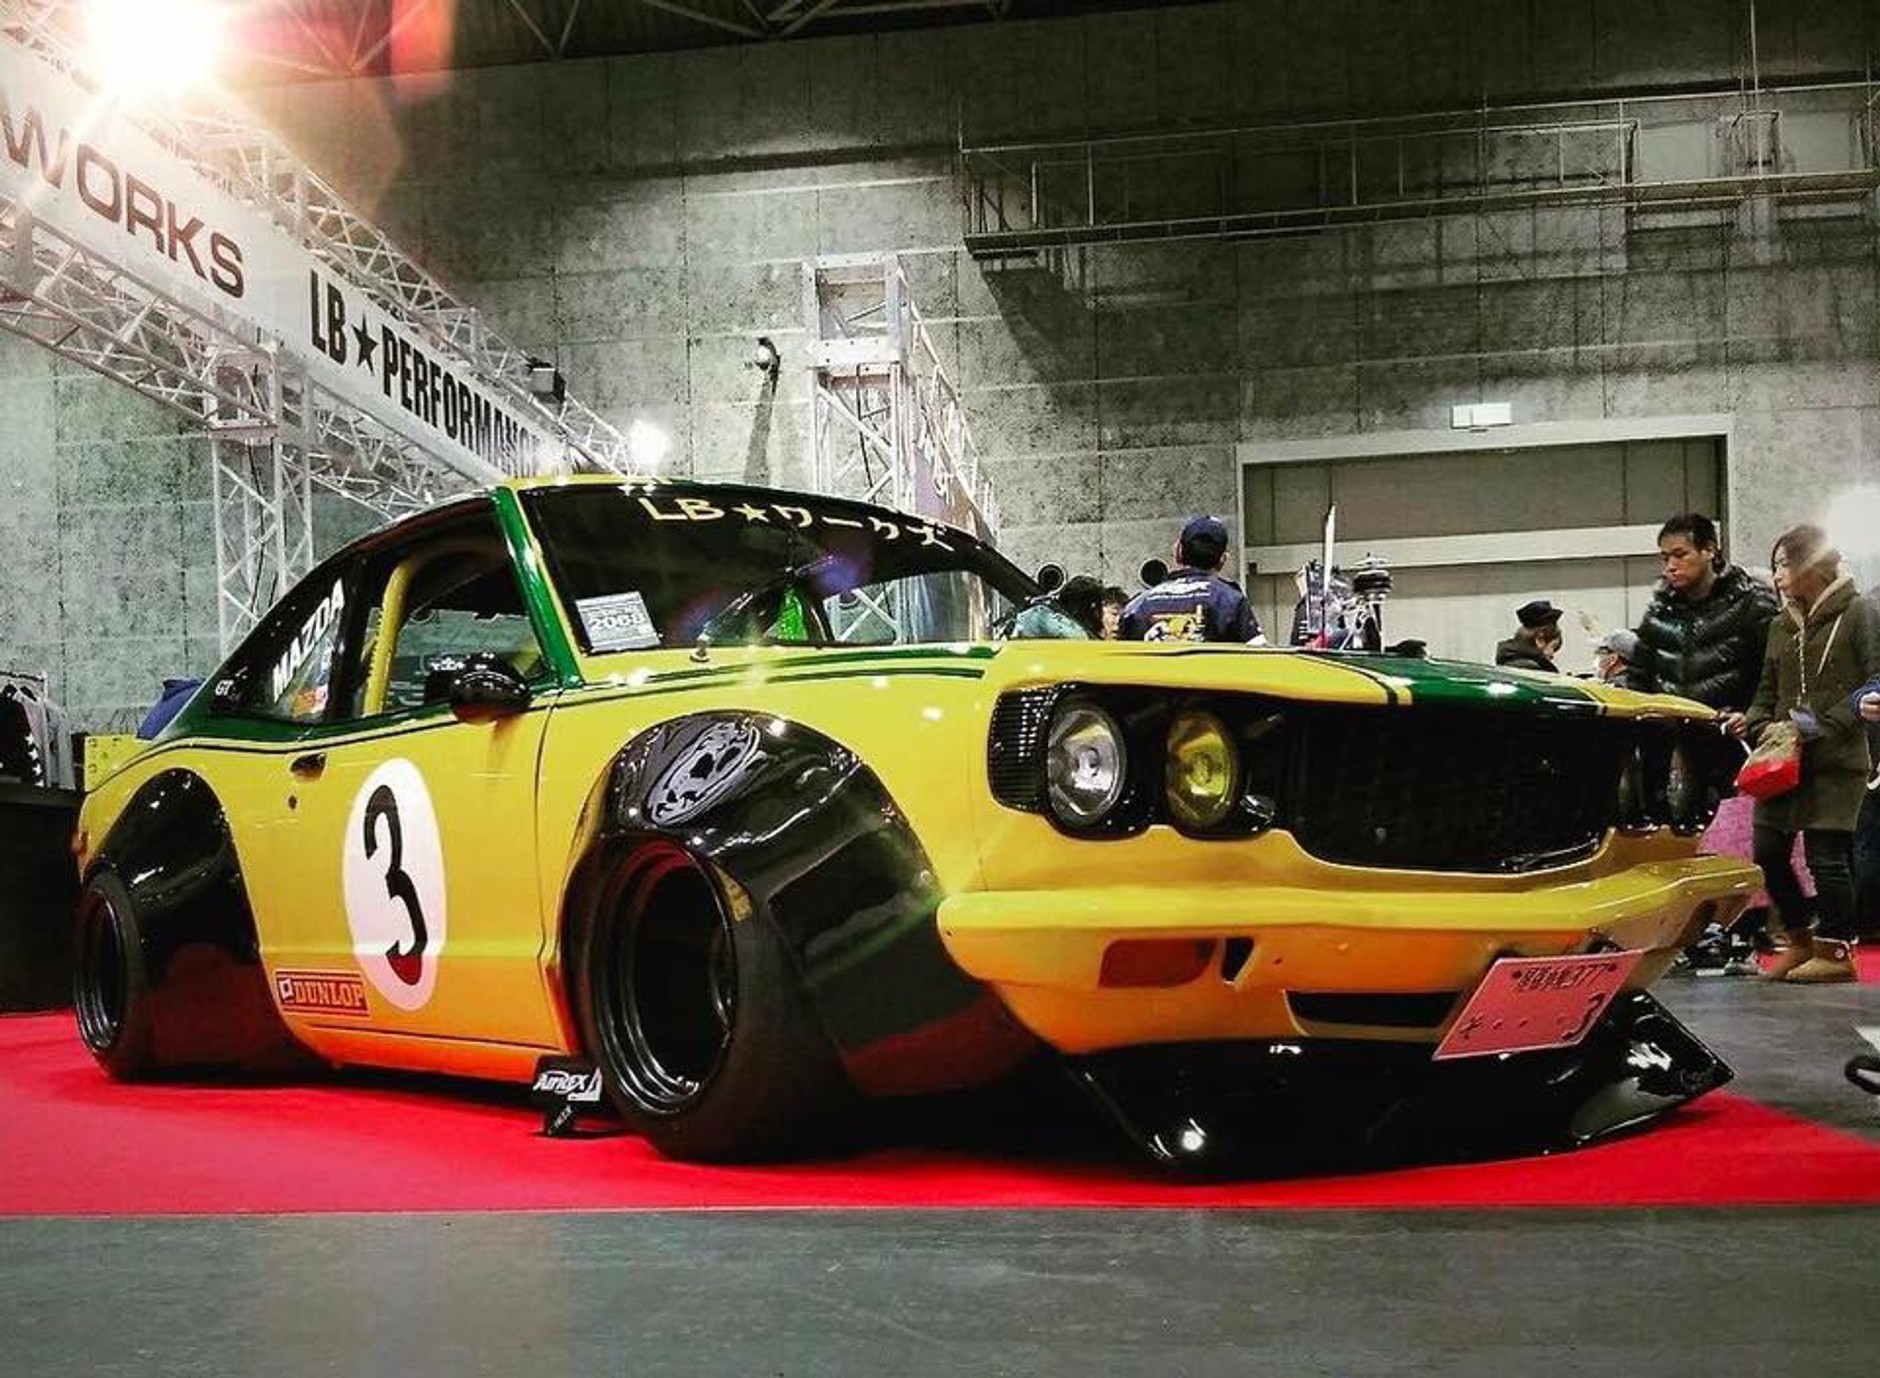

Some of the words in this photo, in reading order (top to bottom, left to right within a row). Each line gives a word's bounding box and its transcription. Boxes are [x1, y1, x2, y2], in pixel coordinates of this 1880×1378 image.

[1, 105, 245, 299] WORKS
[272, 577, 346, 704] MAZDA
[363, 784, 429, 986] 3
[293, 981, 364, 1008] DUNLOP
